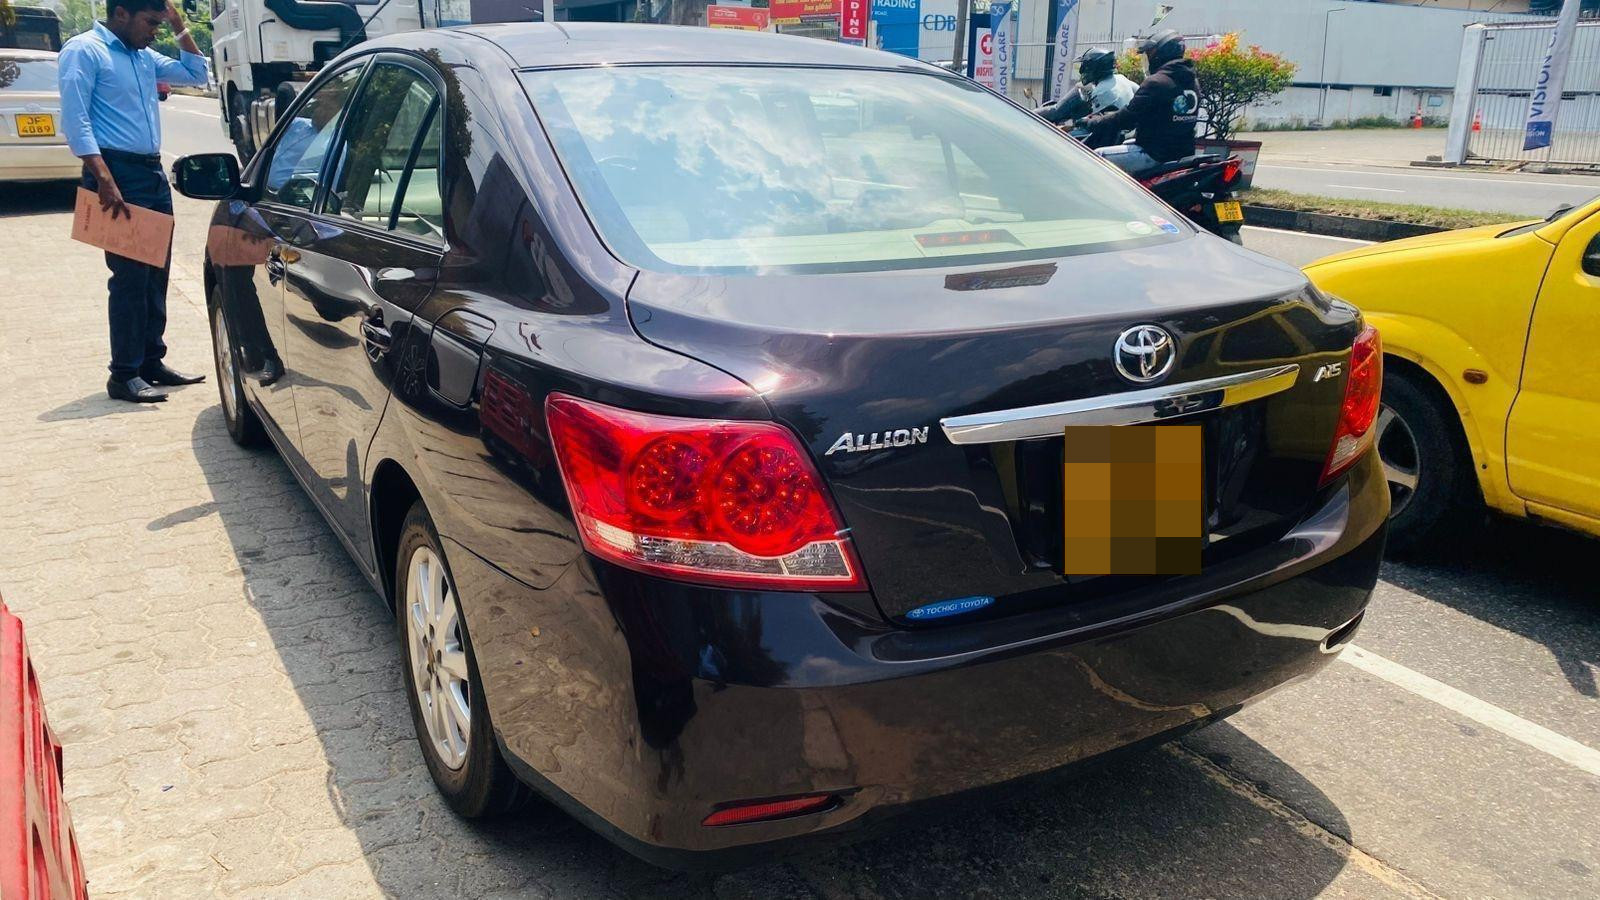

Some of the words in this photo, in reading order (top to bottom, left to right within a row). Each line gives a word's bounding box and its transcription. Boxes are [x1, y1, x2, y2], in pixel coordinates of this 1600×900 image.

[923, 14, 957, 32] CDB
[997, 31, 1008, 61] CARE
[1053, 62, 1067, 99] ISION
[1060, 24, 1070, 57] CARE
[999, 66, 1008, 96] SION
[1313, 362, 1342, 382] A15
[825, 426, 929, 456] ALLION
[927, 603, 958, 615] TOCHIGI
[961, 598, 990, 609] TOYOTA
